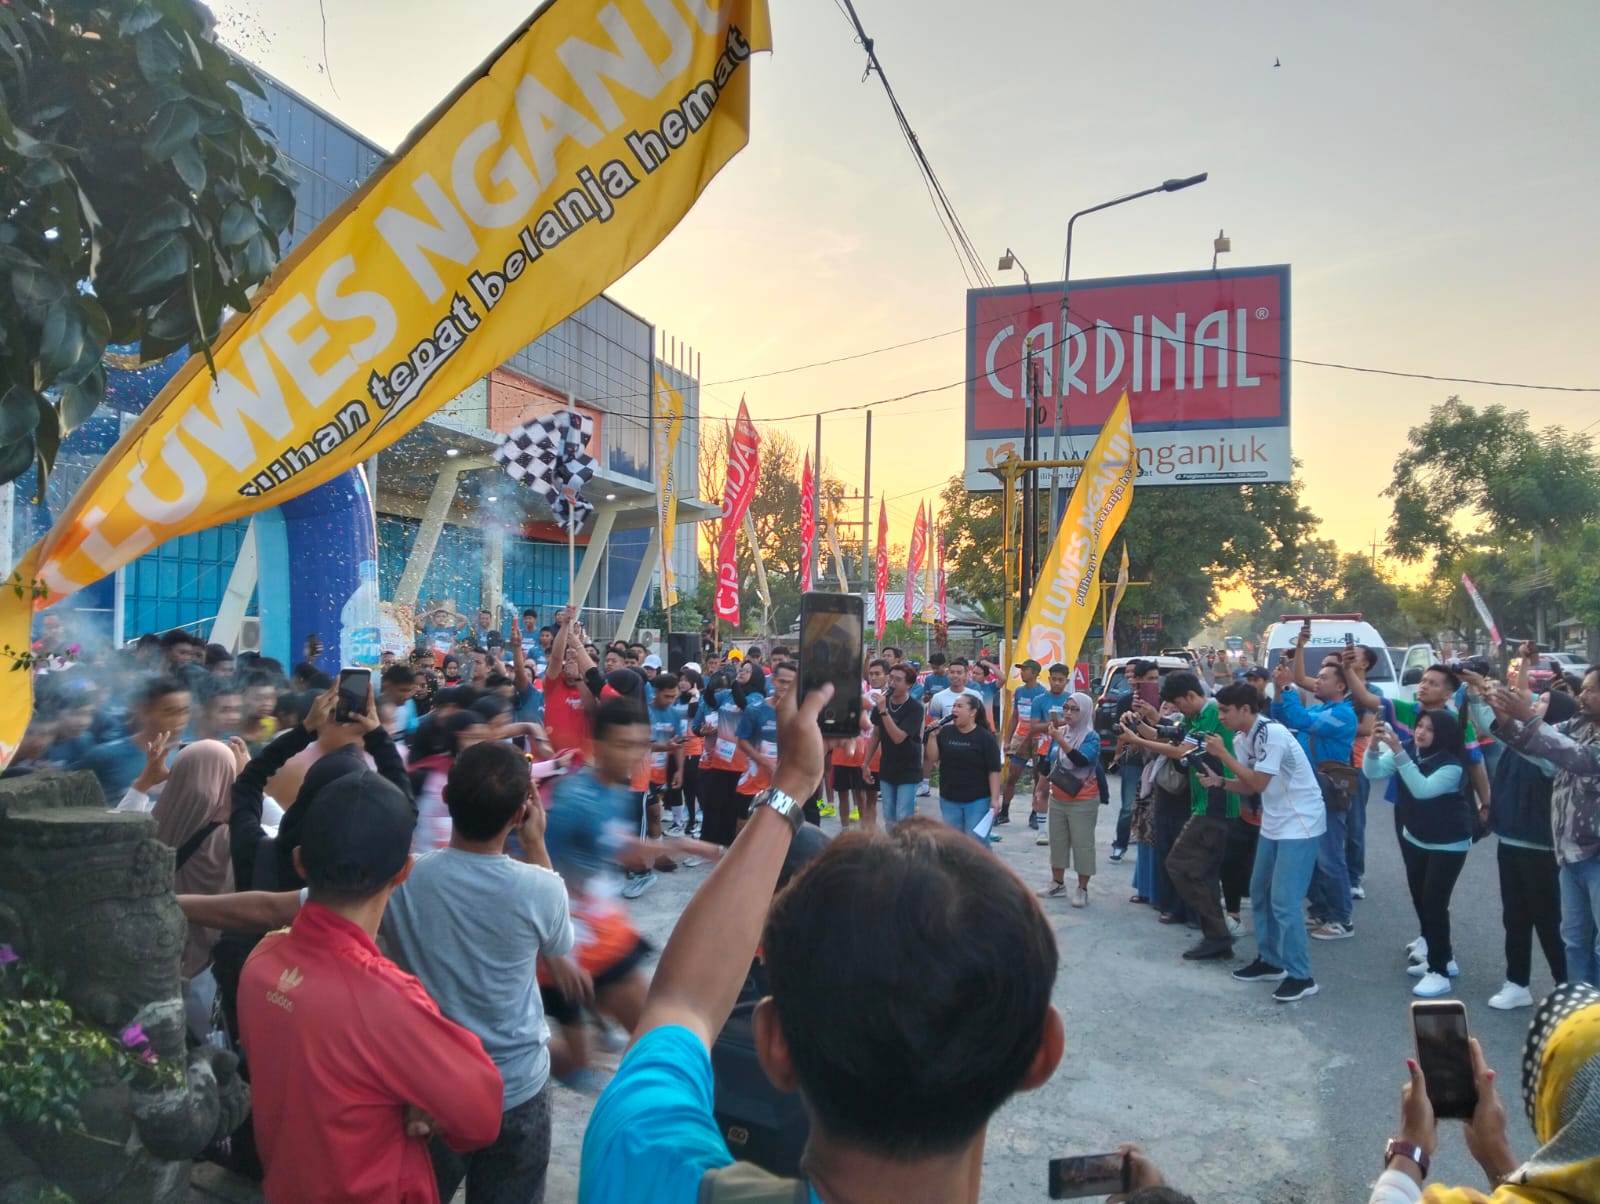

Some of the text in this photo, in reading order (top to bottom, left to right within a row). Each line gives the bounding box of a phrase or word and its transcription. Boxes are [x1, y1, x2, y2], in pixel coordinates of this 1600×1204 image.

[366, 291, 481, 418] tepat
[467, 159, 640, 313] belanja
[624, 24, 751, 175] hemat
[1040, 531, 1091, 624] LUWES
[1075, 557, 1099, 608] pilihan
